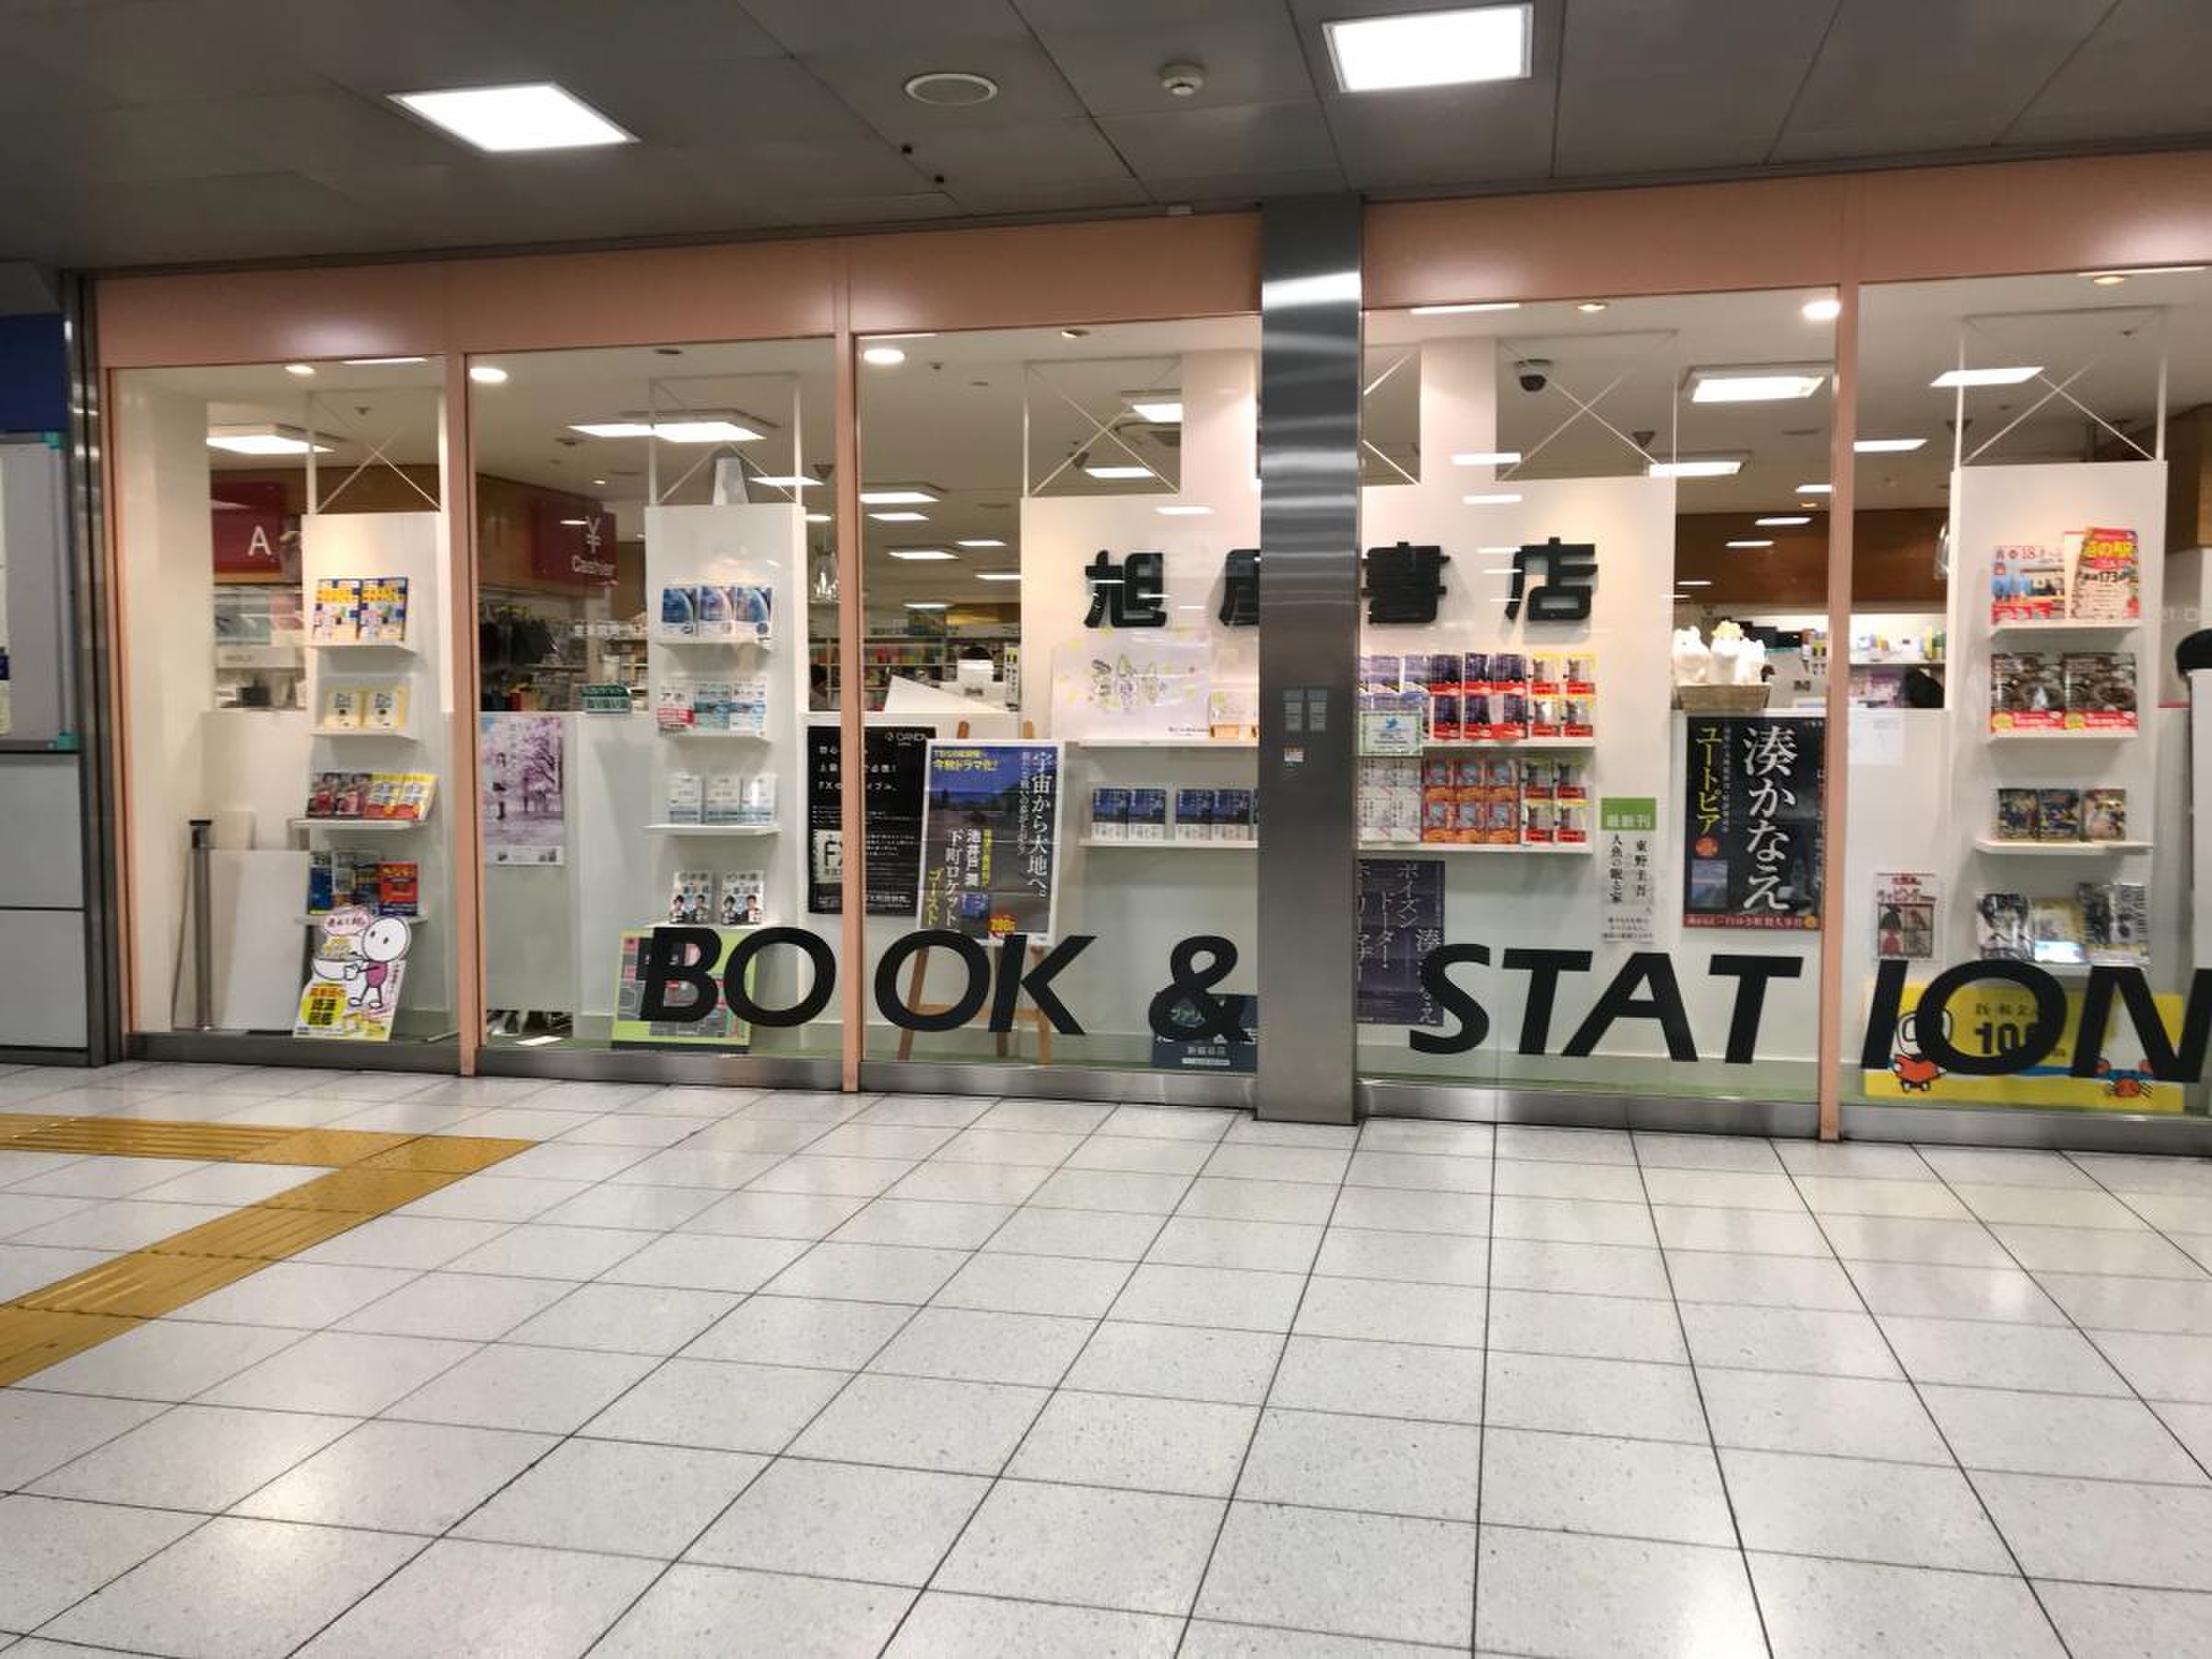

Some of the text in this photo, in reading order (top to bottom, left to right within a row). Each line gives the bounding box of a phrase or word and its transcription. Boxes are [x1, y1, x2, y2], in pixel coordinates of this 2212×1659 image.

[248, 526, 271, 556] A
[1696, 727, 1723, 834] ユートピア
[1741, 725, 1798, 911] 湊かなえ
[927, 867, 945, 926] ゴースト
[944, 828, 963, 927] 下町ロケット
[640, 926, 2212, 1082] BOOK & STATION
